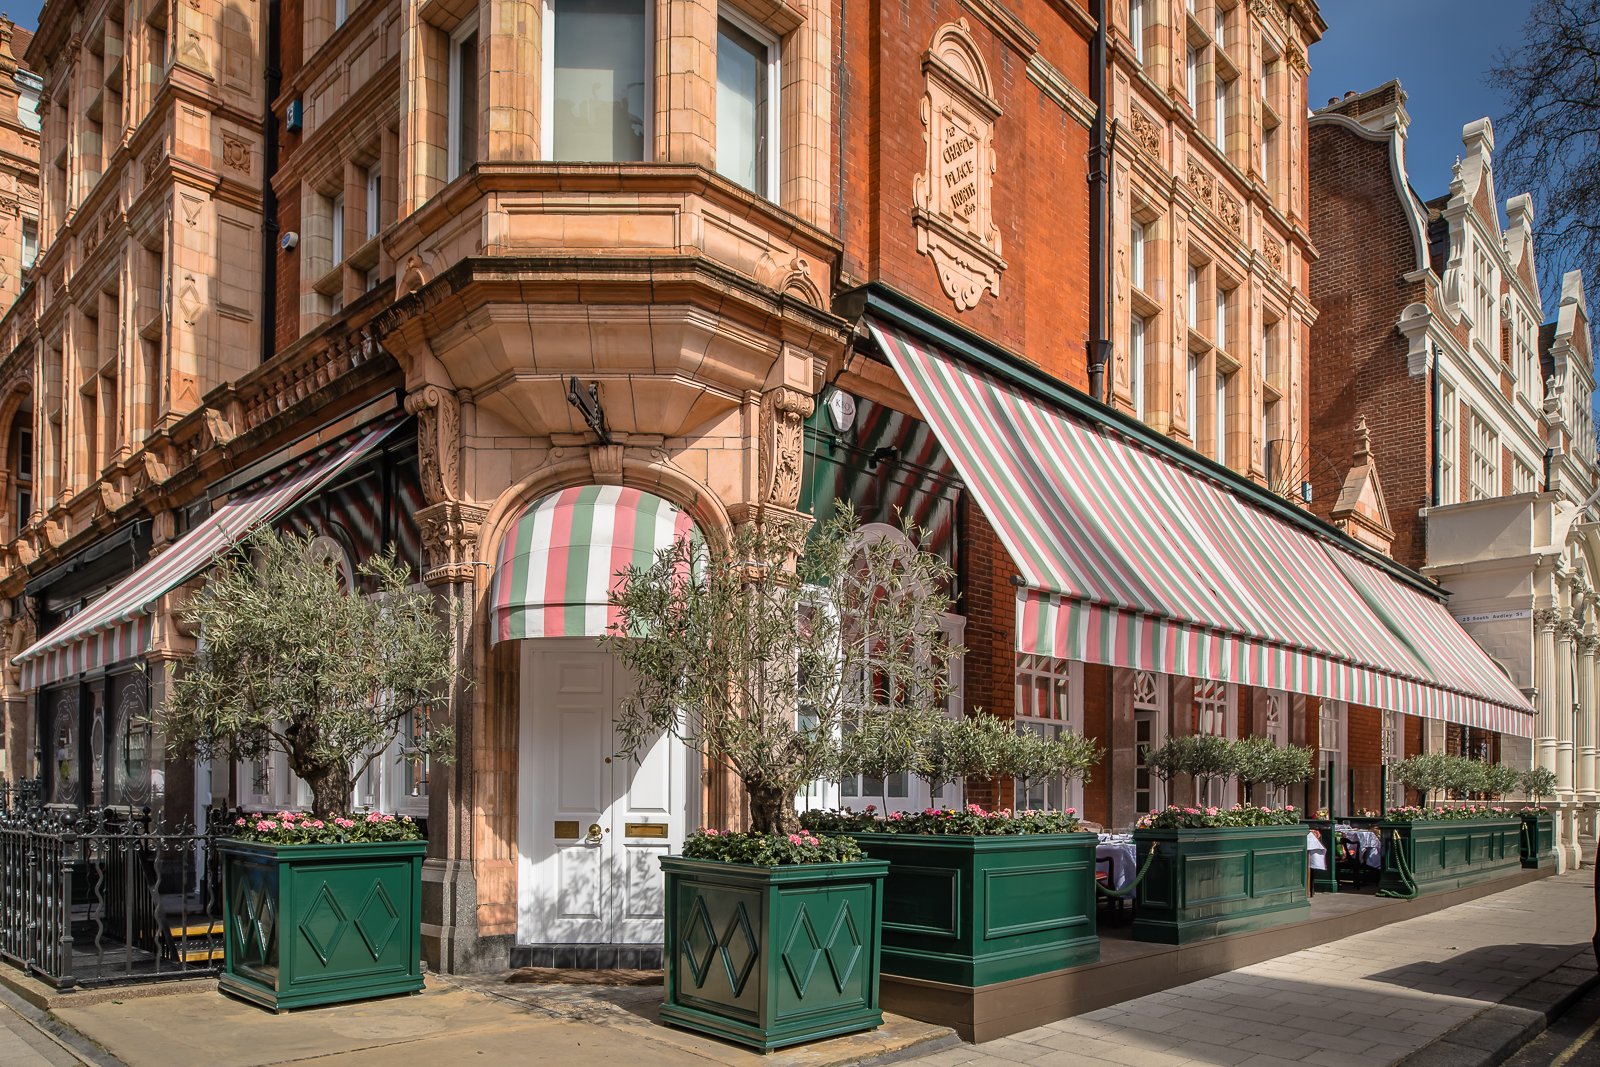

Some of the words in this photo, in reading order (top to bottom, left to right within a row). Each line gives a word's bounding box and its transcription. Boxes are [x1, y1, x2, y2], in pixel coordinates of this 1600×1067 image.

[942, 137, 974, 164] CHAPEL
[944, 160, 974, 188] PLACE
[950, 182, 976, 209] NORTH
